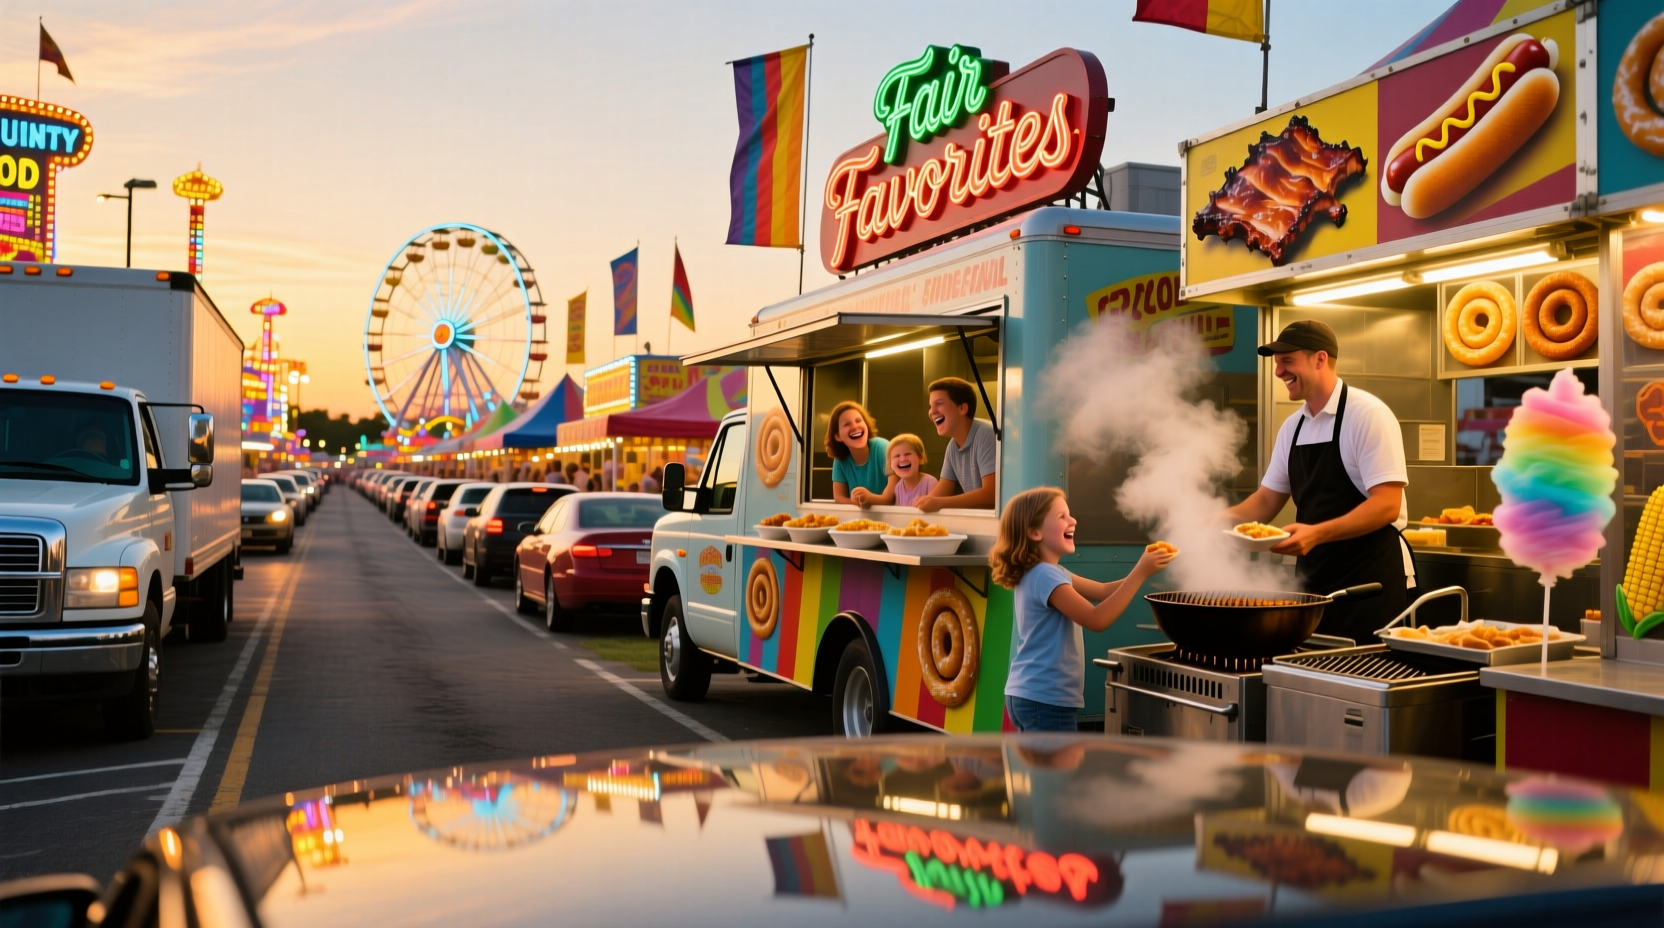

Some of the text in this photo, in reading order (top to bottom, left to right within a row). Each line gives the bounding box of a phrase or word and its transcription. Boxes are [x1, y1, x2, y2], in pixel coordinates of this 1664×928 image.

[1, 118, 79, 153] UINTY
[874, 47, 987, 163] Fair
[826, 93, 1080, 268] Favorites
